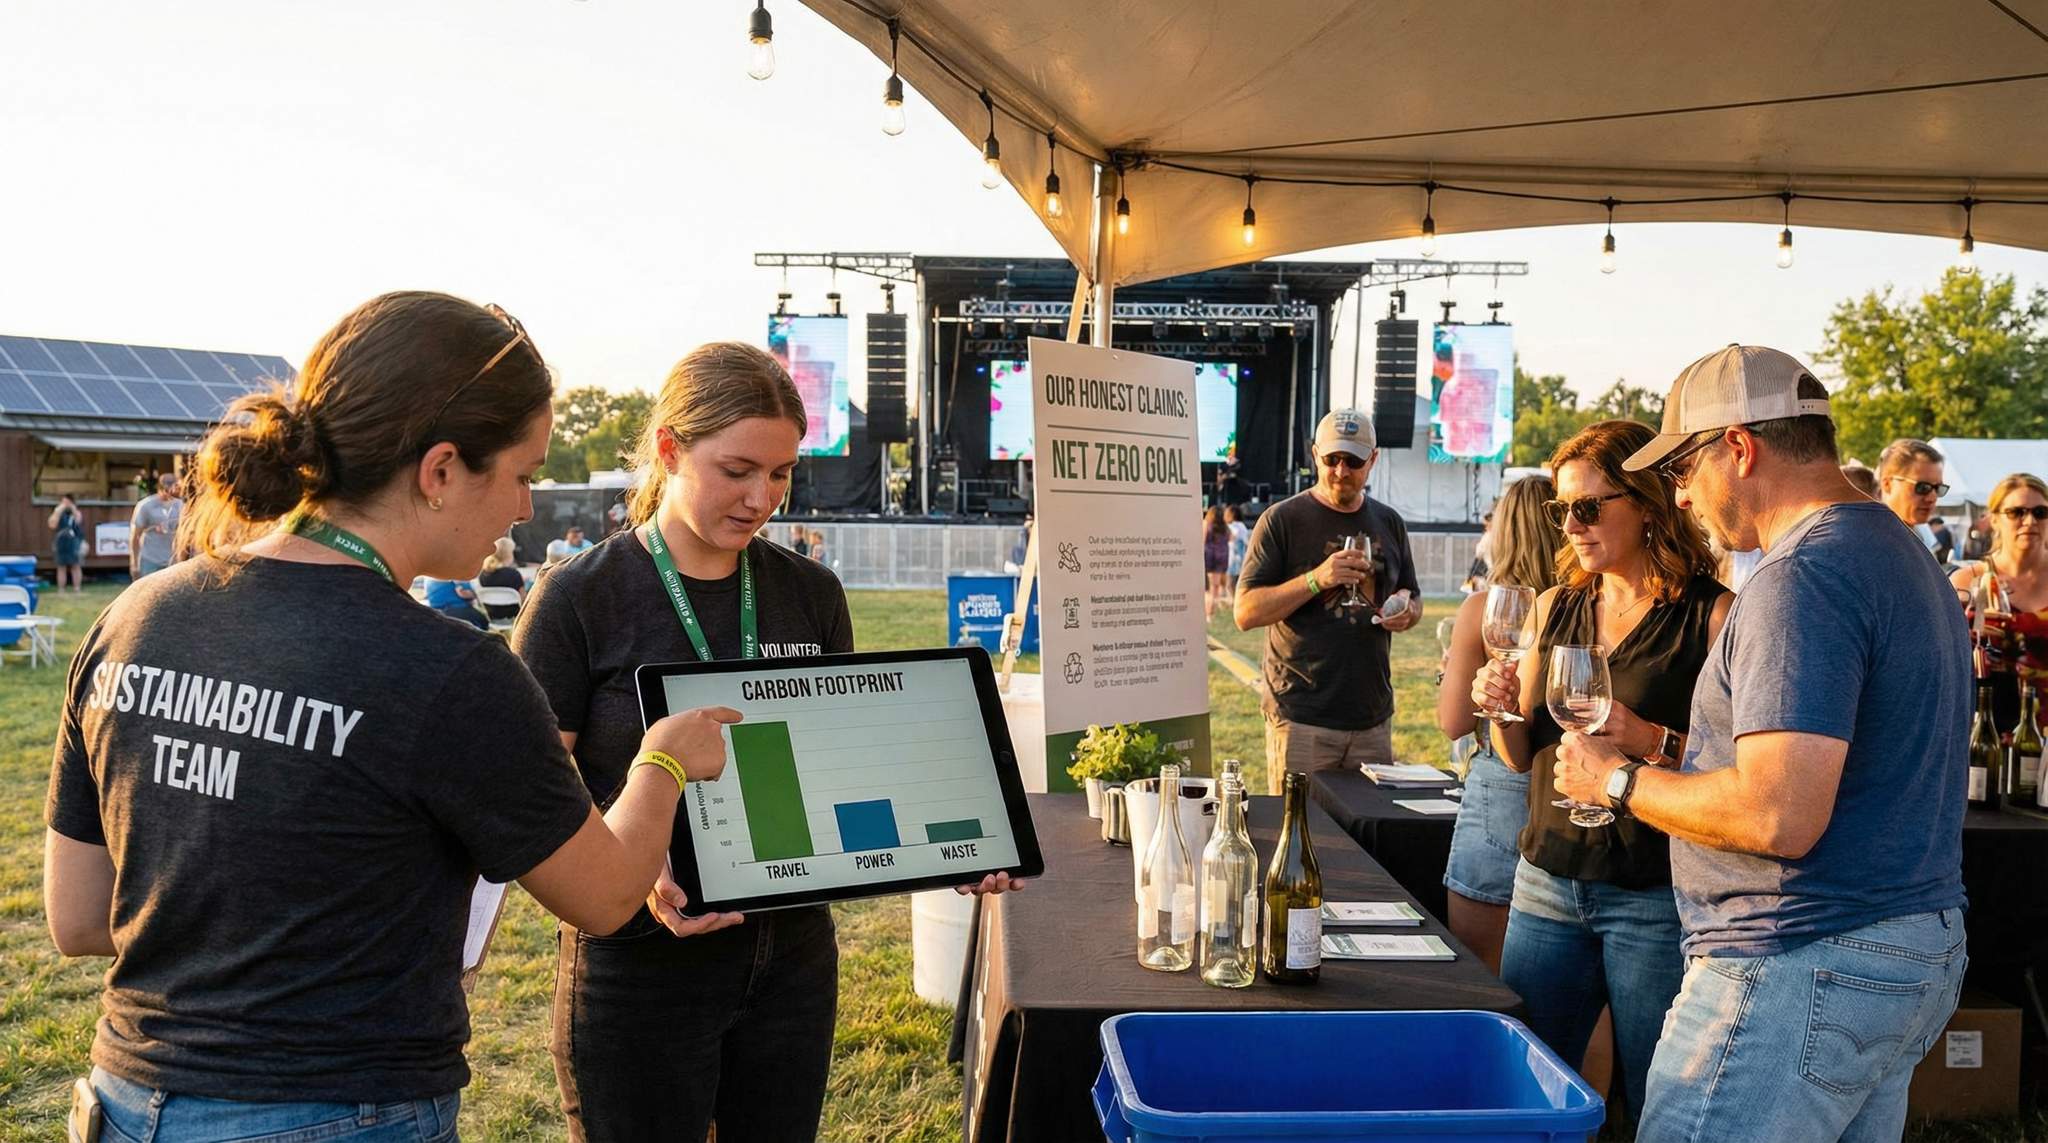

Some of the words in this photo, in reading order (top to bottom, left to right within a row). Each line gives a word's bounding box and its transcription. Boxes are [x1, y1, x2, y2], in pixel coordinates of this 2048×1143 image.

[1045, 374, 1076, 406] OUR
[1079, 378, 1133, 412] HONEST
[1137, 385, 1188, 418] CLAIMS:
[1052, 440, 1089, 480] NET
[1094, 442, 1140, 482] ZERO
[1145, 446, 1188, 485] GOAL
[741, 677, 812, 701] CARBON
[816, 671, 904, 696] FOOTPRINT
[89, 661, 364, 757] SUSTAINABILITY
[152, 734, 240, 800] TEAM
[855, 853, 895, 869] POWER
[940, 843, 978, 860] WASTE
[766, 862, 810, 879] TRAVEL
